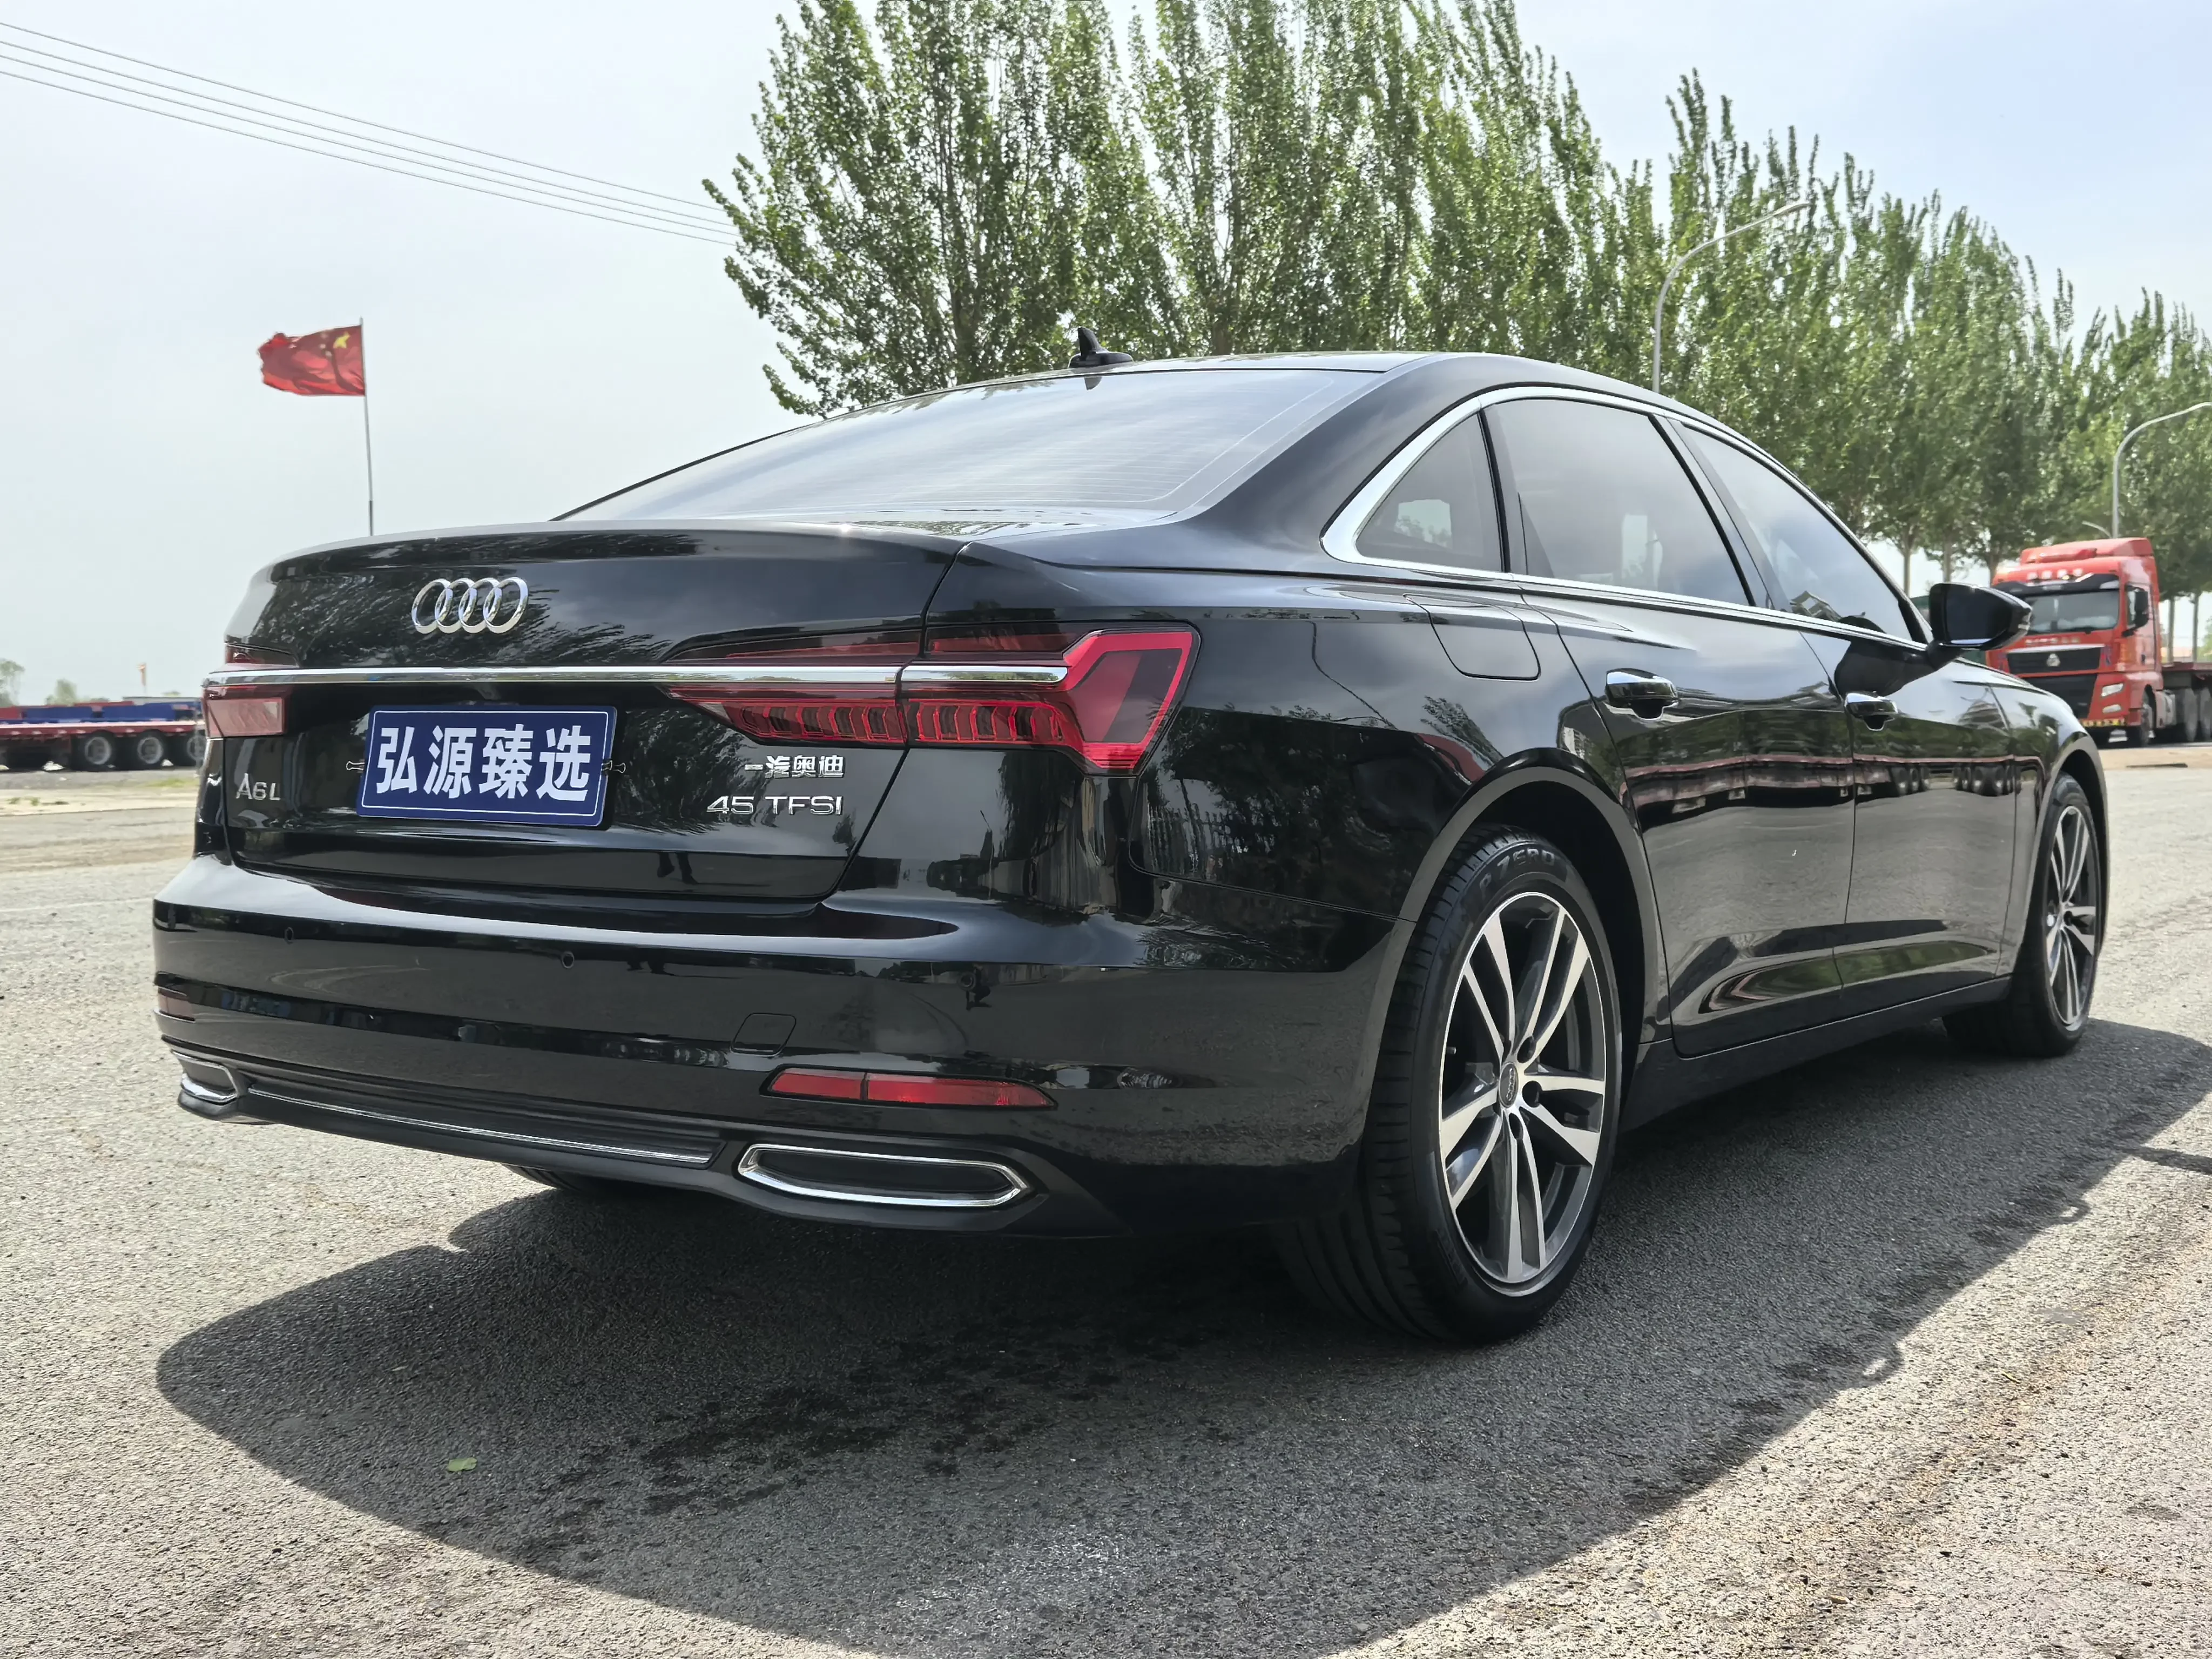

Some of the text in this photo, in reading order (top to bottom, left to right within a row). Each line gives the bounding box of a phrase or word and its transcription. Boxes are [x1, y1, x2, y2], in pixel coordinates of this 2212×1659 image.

[376, 724, 591, 801] 弘源臻选
[744, 755, 844, 778] 一汽奥迪
[235, 772, 281, 800] A6L
[706, 795, 842, 815] 45 TFSI
